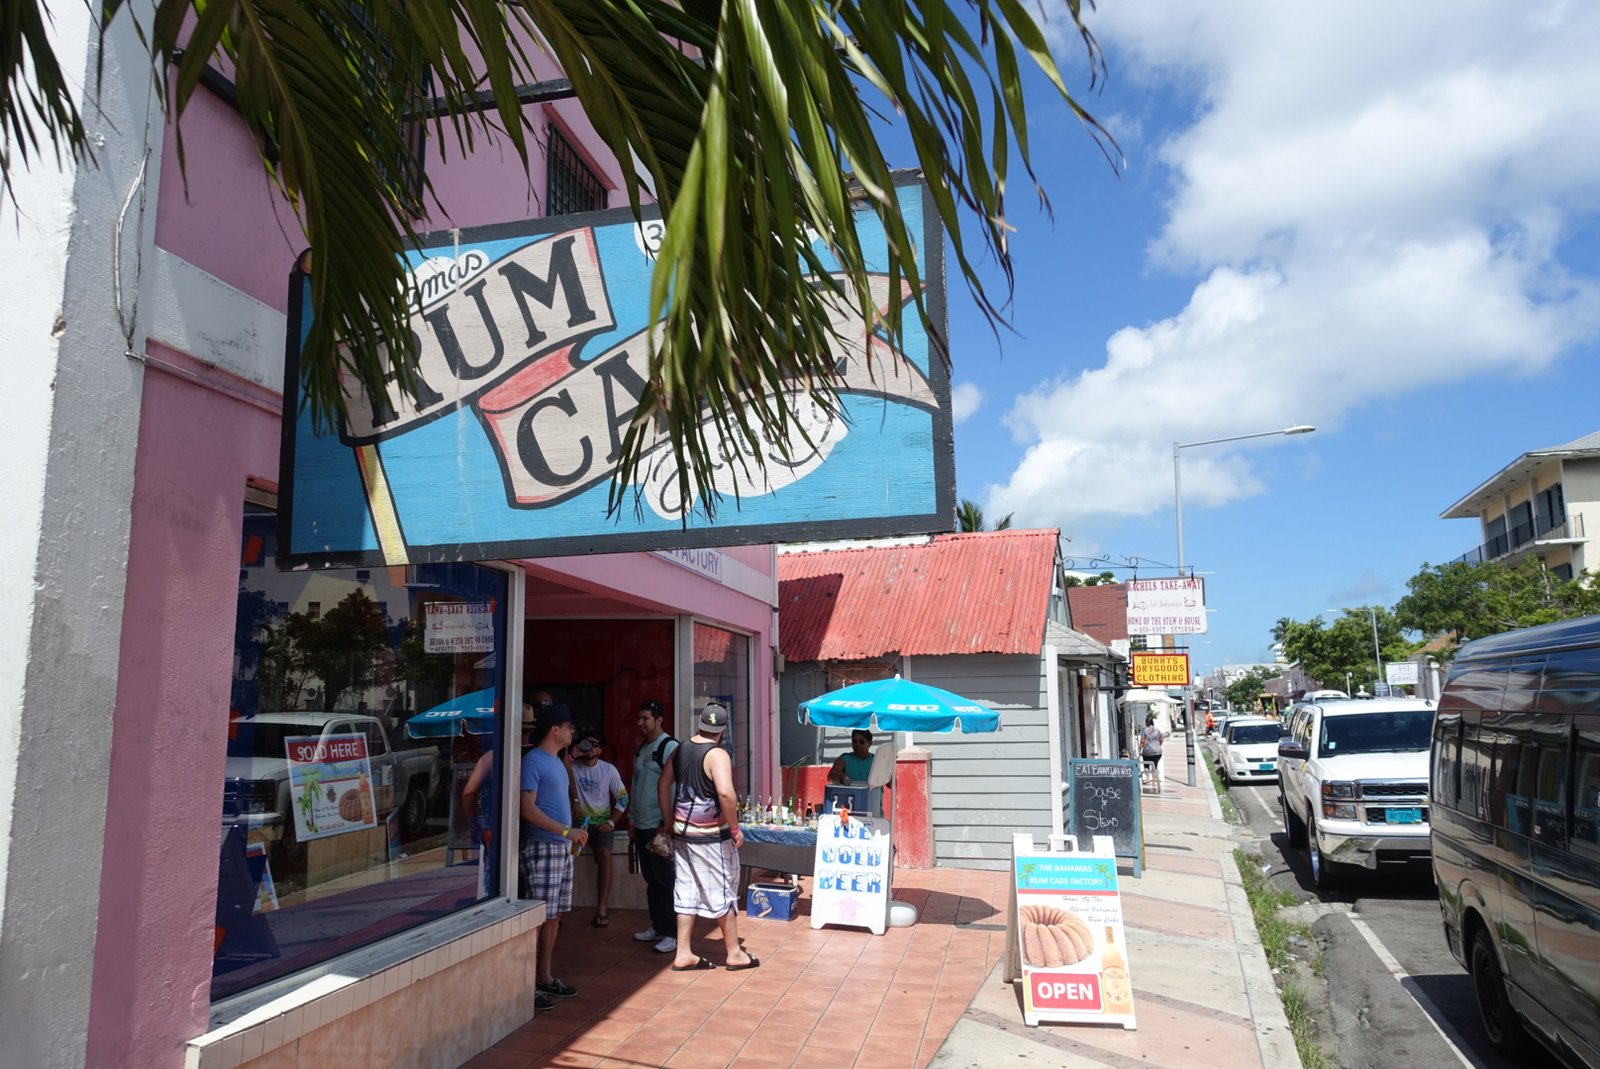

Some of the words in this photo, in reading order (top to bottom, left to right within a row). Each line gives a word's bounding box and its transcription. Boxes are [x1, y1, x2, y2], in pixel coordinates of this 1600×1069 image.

[1127, 581, 1157, 591] RACHELS
[1160, 579, 1201, 591] TAKE-AWAY
[1151, 617, 1161, 625] THE
[1163, 617, 1177, 625] STEW
[1136, 664, 1185, 672] DRYGOODS
[297, 744, 328, 761] SOLD
[330, 742, 359, 759] HERE
[833, 819, 873, 840] ICE
[822, 844, 881, 867] COLD
[1038, 864, 1052, 872] THE
[1054, 864, 1093, 872] BAHAMAS
[819, 869, 881, 894] BEER
[1037, 982, 1094, 1000] OPEN
